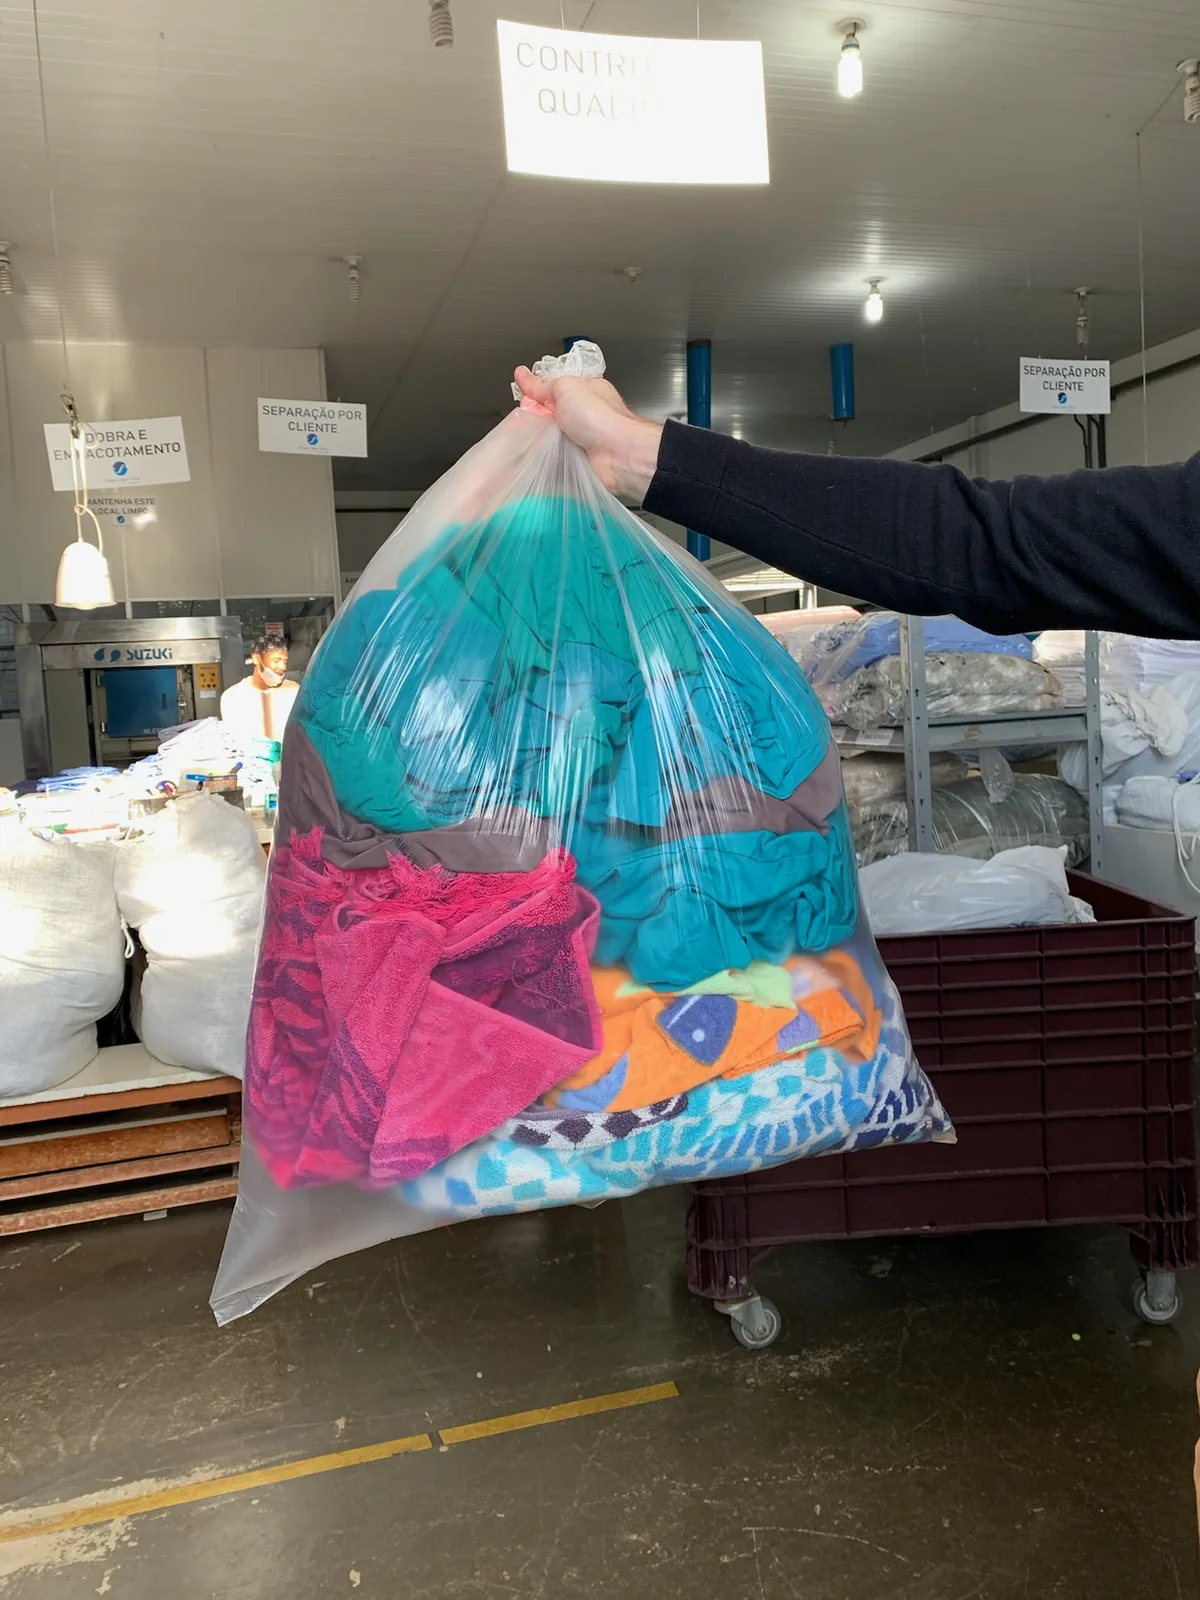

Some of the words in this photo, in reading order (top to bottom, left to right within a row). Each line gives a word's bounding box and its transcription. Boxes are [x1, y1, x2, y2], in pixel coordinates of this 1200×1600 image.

[1023, 365, 1082, 379] SEPARAÇÃO
[1084, 367, 1106, 377] POR
[1042, 380, 1084, 391] CLIENTE
[262, 405, 335, 420] SEPARAÇÃO
[338, 410, 362, 420] POR
[288, 421, 338, 433] CLIENTE
[85, 430, 136, 444] DOBRA
[138, 429, 148, 440] E
[93, 507, 120, 515] LOCAL
[122, 507, 149, 515] LIMPO
